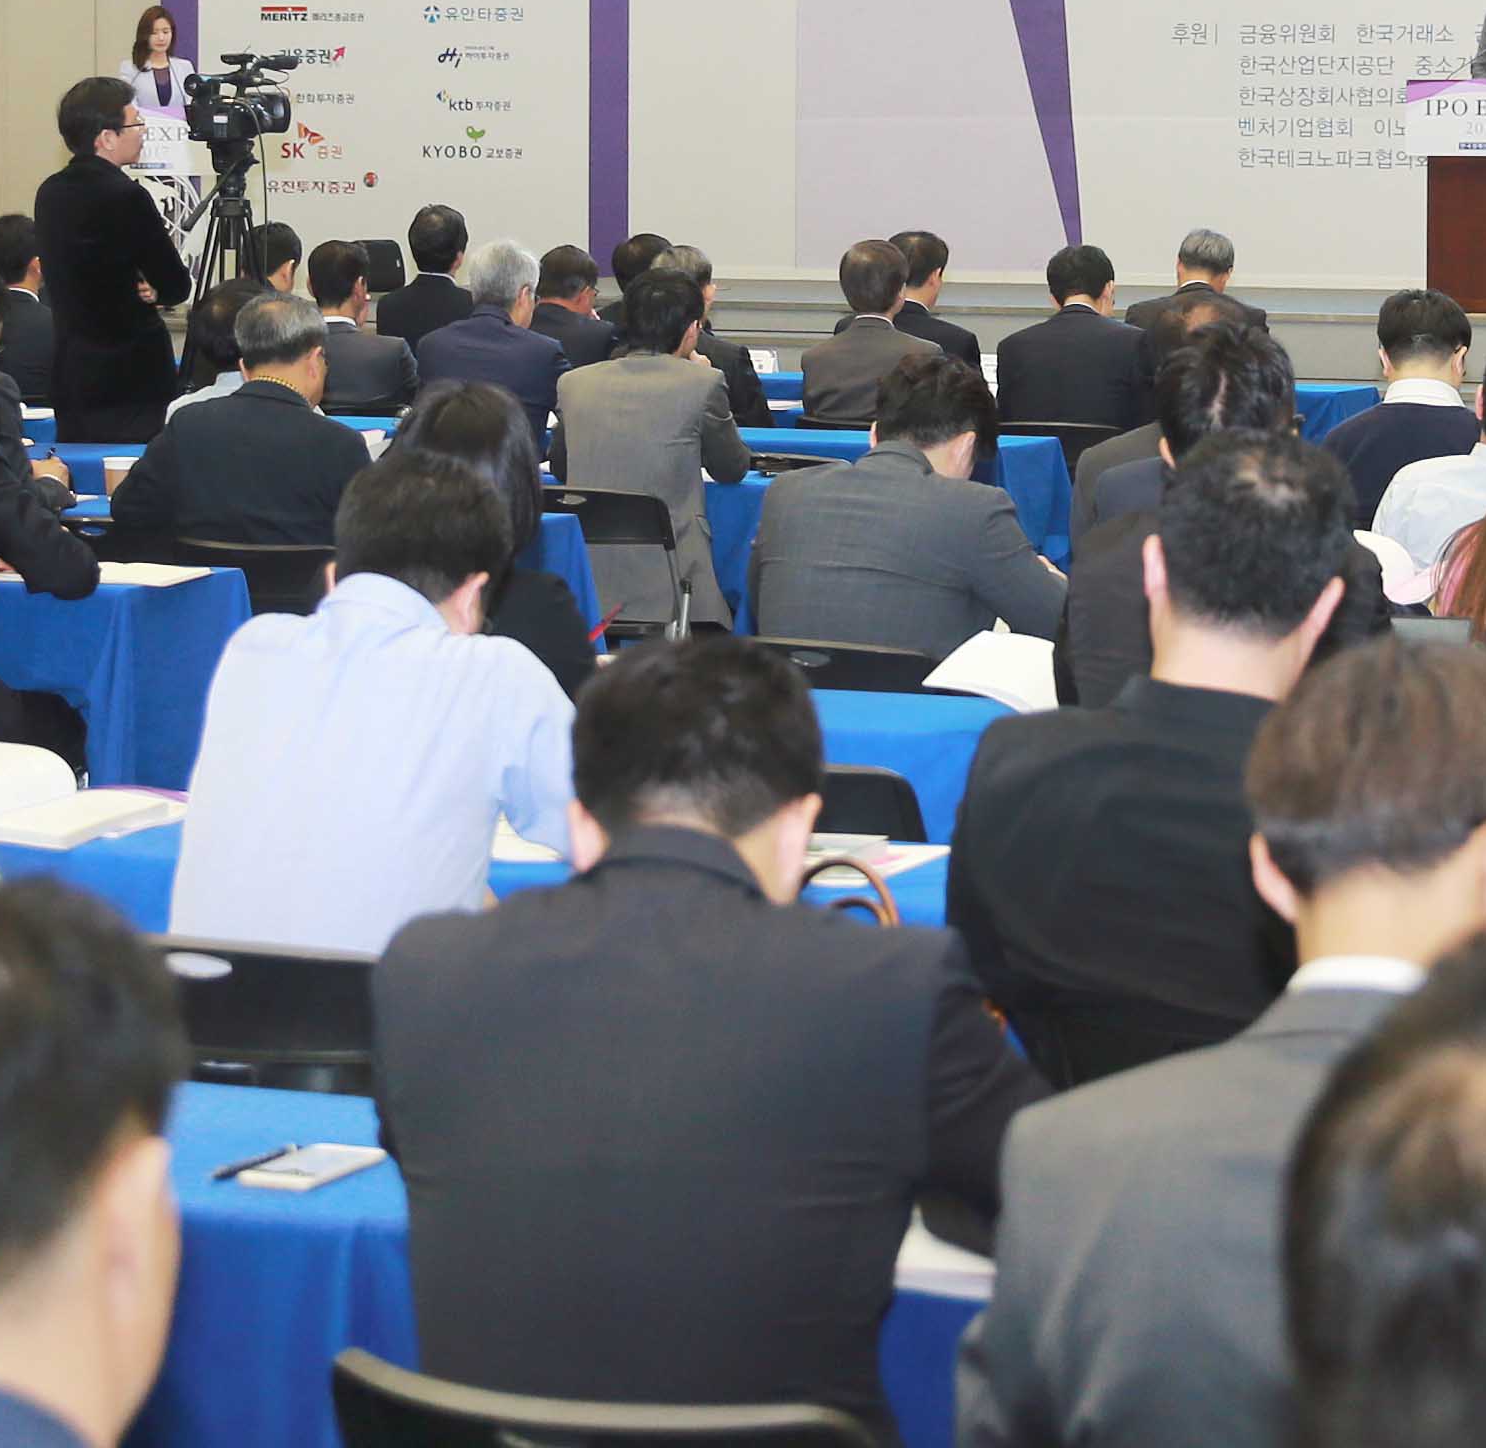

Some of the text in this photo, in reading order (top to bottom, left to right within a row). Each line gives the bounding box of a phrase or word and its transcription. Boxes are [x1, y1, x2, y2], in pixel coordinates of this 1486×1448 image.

[261, 13, 307, 21] MERITZ
[445, 8, 523, 21] 유안타증권
[1172, 23, 1207, 45] 후원
[1240, 24, 1334, 44] 금융위원회
[1357, 24, 1454, 44] 한국거래소
[1240, 56, 1393, 76] 한국산업단지공단
[450, 99, 473, 111] ktb
[1423, 97, 1467, 115] IPO
[146, 125, 191, 142] EXP
[1239, 117, 1352, 138] 벤처기업협회
[281, 143, 342, 159] SK 증권
[423, 146, 522, 159] KYOBO 교보증권
[267, 181, 355, 194] 유진투자증권
